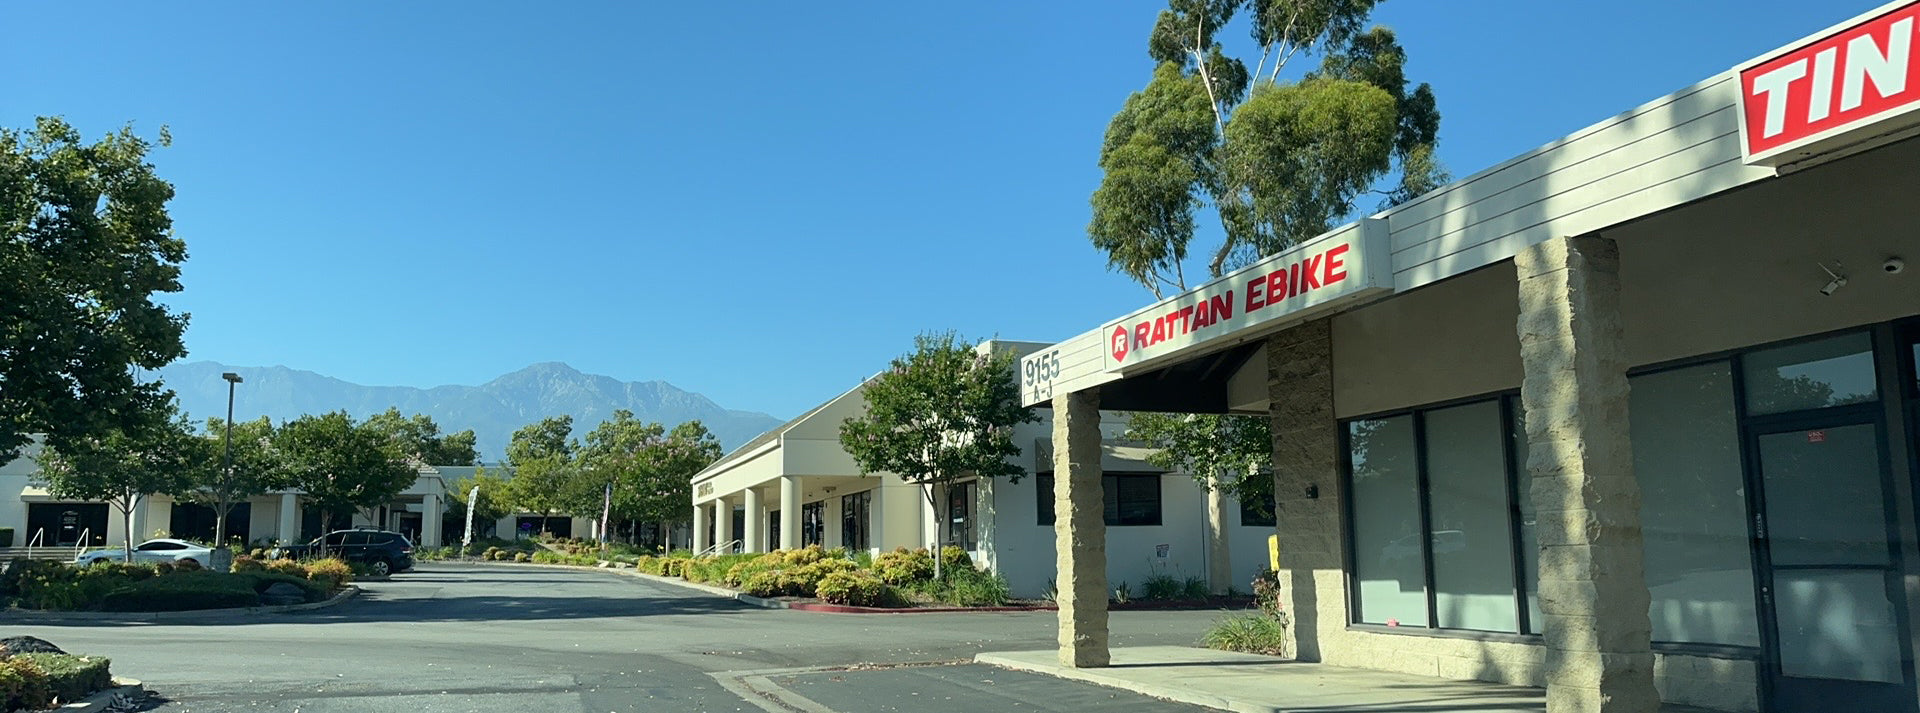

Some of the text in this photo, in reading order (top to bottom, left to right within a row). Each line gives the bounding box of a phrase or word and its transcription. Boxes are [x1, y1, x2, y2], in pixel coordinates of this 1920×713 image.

[1753, 16, 1920, 139] TIN
[1133, 290, 1233, 351] RATTAN
[1246, 243, 1350, 313] EBIKE
[1026, 350, 1060, 387] 9155
[1034, 380, 1053, 403] A-J
